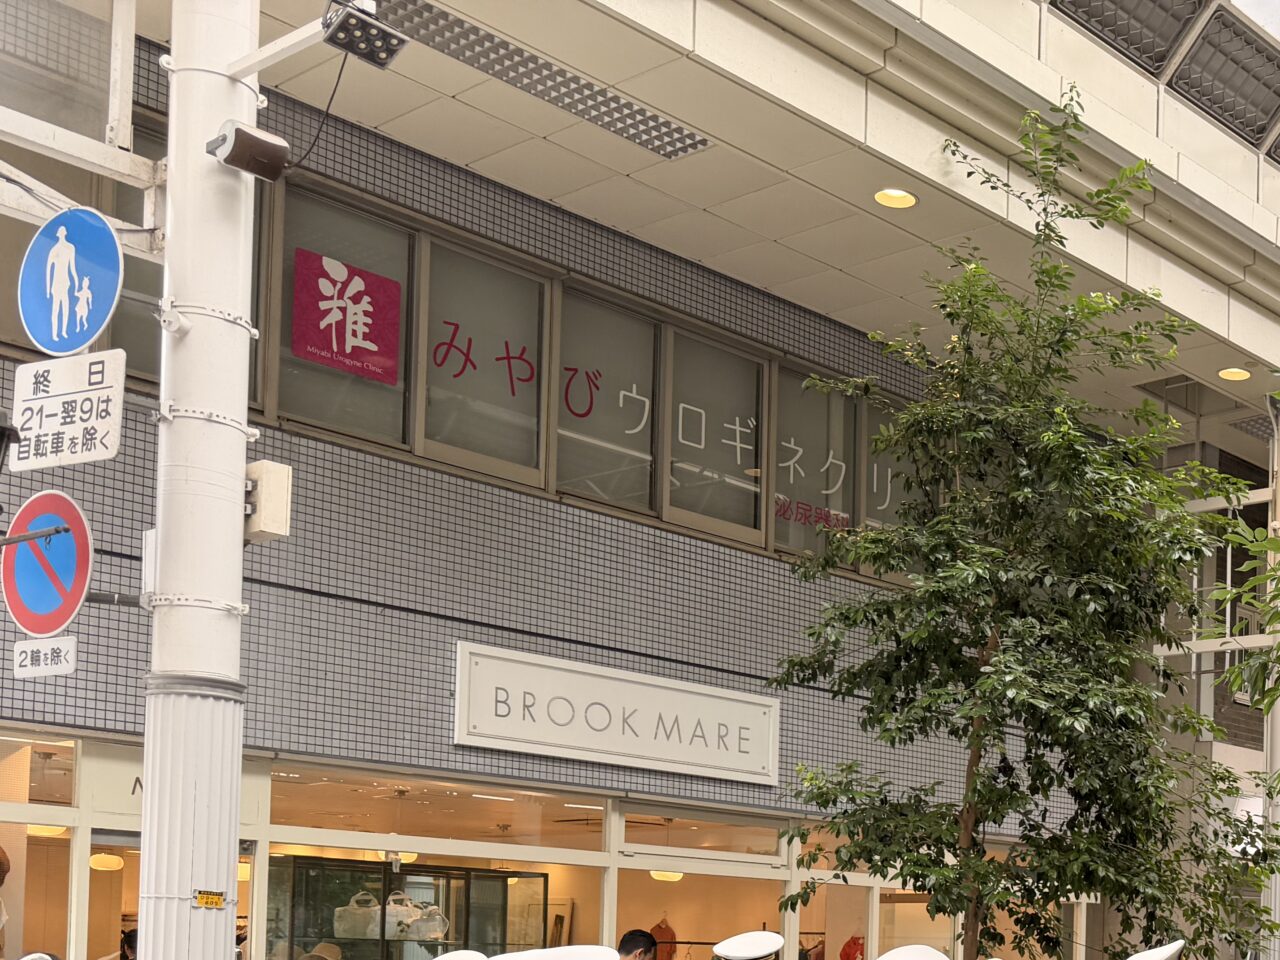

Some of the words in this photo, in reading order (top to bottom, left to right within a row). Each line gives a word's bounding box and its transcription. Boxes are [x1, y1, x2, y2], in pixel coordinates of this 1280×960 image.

[318, 256, 378, 353] 雅
[306, 345, 331, 358] Miyabi
[333, 353, 363, 369] Urogyne
[364, 362, 384, 374] Clinic
[17, 425, 110, 461] 自転車を除く
[19, 647, 70, 668] 2輪を除く
